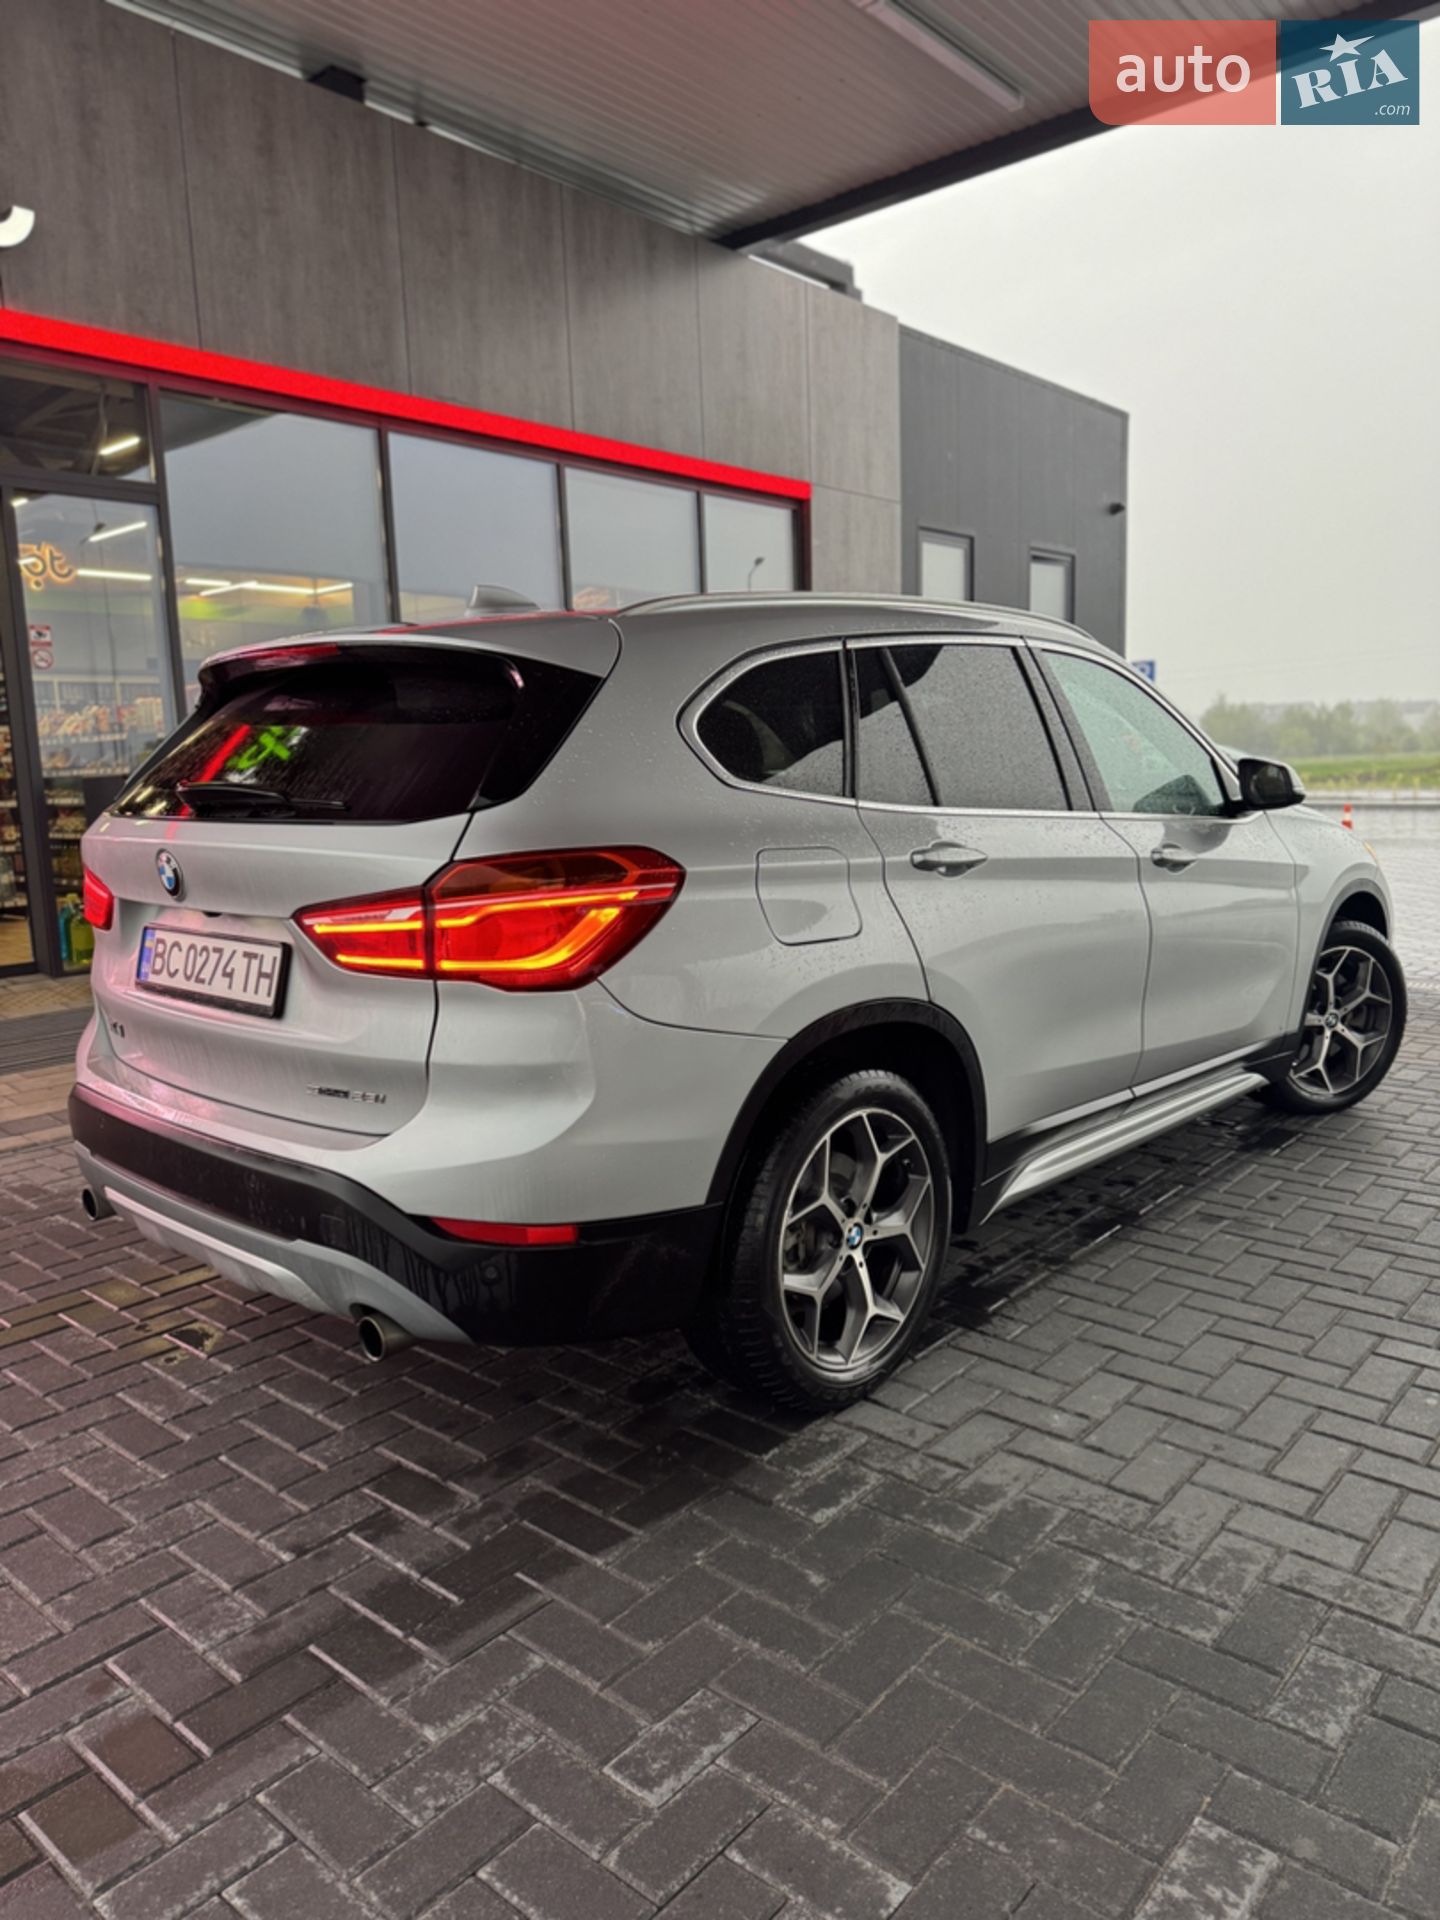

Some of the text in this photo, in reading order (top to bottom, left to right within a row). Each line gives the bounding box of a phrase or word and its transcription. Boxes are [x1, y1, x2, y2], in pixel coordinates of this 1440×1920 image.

[151, 938, 277, 998] BC 0274 TH
